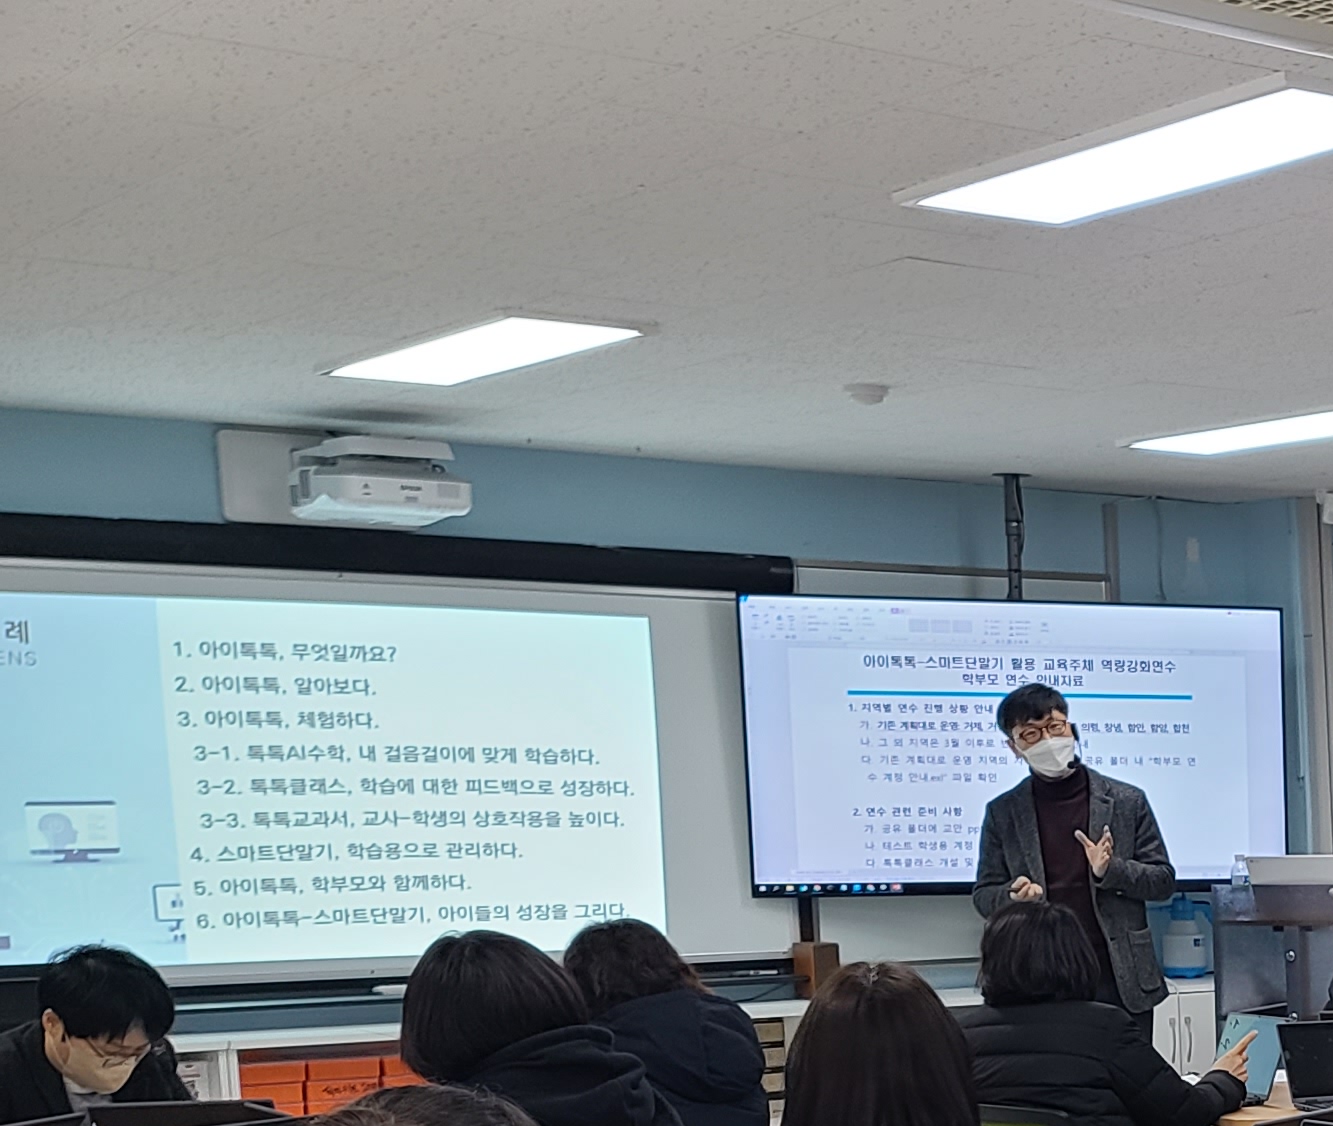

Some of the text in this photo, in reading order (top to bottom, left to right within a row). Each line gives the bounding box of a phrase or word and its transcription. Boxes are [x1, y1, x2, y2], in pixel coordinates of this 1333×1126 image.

[4, 620, 29, 645] 례
[200, 640, 285, 661] 아이톡톡,
[291, 643, 396, 662] 무엇일까요?
[1011, 658, 1036, 672] 활용
[1044, 658, 1094, 672] 교육주체
[1101, 659, 1177, 673] 역량강화연수
[174, 676, 377, 696] 2. 아이톡톡, 알아보다.
[962, 673, 999, 686] 학부모
[177, 710, 379, 729] 3. 아이톡톡, 체험하다.
[194, 745, 239, 761] 3-1.
[359, 745, 377, 762] 내
[384, 745, 475, 763] 걸음걸이에
[482, 747, 517, 763] 맞게
[525, 747, 600, 765] 학습하다.
[197, 778, 635, 797] 3-2. 톡톡클래스, 학습에 대한 피드백으로 성장하다.
[201, 810, 625, 829] 3-3. 톡톡교과서, 교사-학생의 상호작용을 높이다.
[190, 842, 523, 863] 4. 스마트단말기, 학습용으로 관리하다.
[194, 874, 472, 896] 5. 아이톡톡, 학부모와 함께하다.
[197, 914, 216, 929] 6.
[438, 904, 510, 922] 아이들의
[516, 904, 568, 921] 성장을
[574, 903, 630, 919] 그리다.
